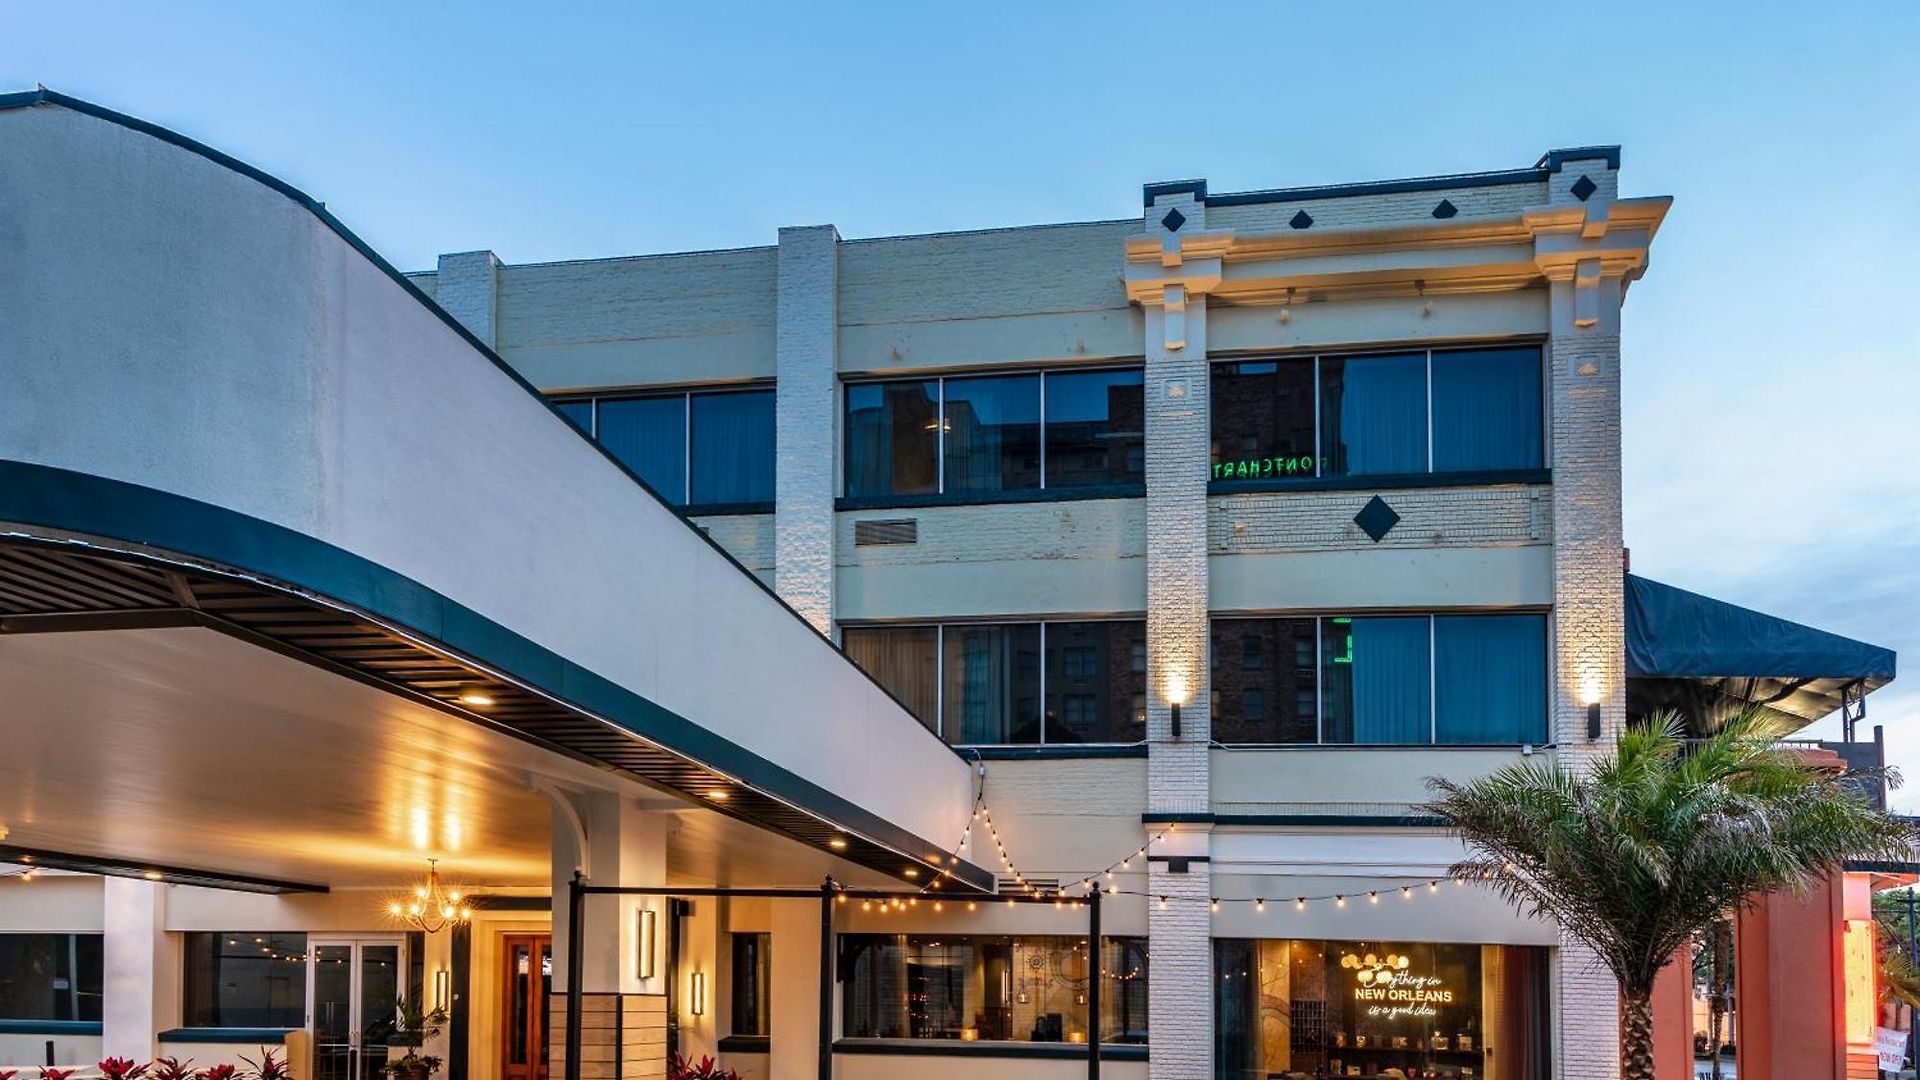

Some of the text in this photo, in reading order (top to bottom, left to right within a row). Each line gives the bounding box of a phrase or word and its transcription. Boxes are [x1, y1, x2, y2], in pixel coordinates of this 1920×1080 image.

[1364, 970, 1442, 989] ything in
[1355, 988, 1452, 1002] NEW ORLEANS
[1368, 1005, 1381, 1015] is
[1389, 1002, 1414, 1019] good
[1414, 1002, 1437, 1016] idea
